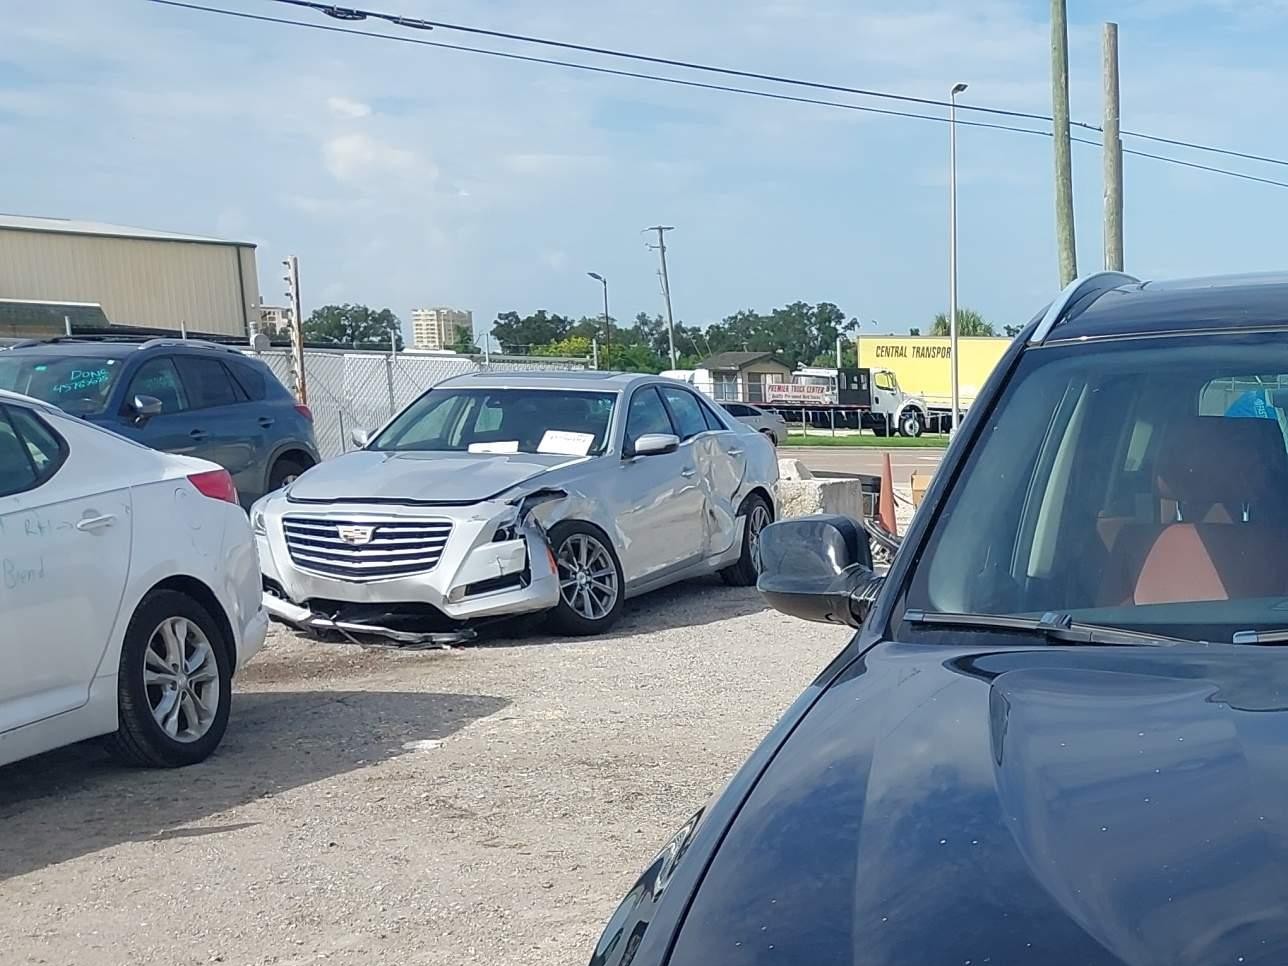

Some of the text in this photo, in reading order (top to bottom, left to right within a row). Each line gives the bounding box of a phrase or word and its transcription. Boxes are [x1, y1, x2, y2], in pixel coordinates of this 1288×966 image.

[876, 345, 951, 359] CENTRAL TRANSPOR
[791, 385, 805, 393] TRUCK
[806, 386, 825, 394] CENTER
